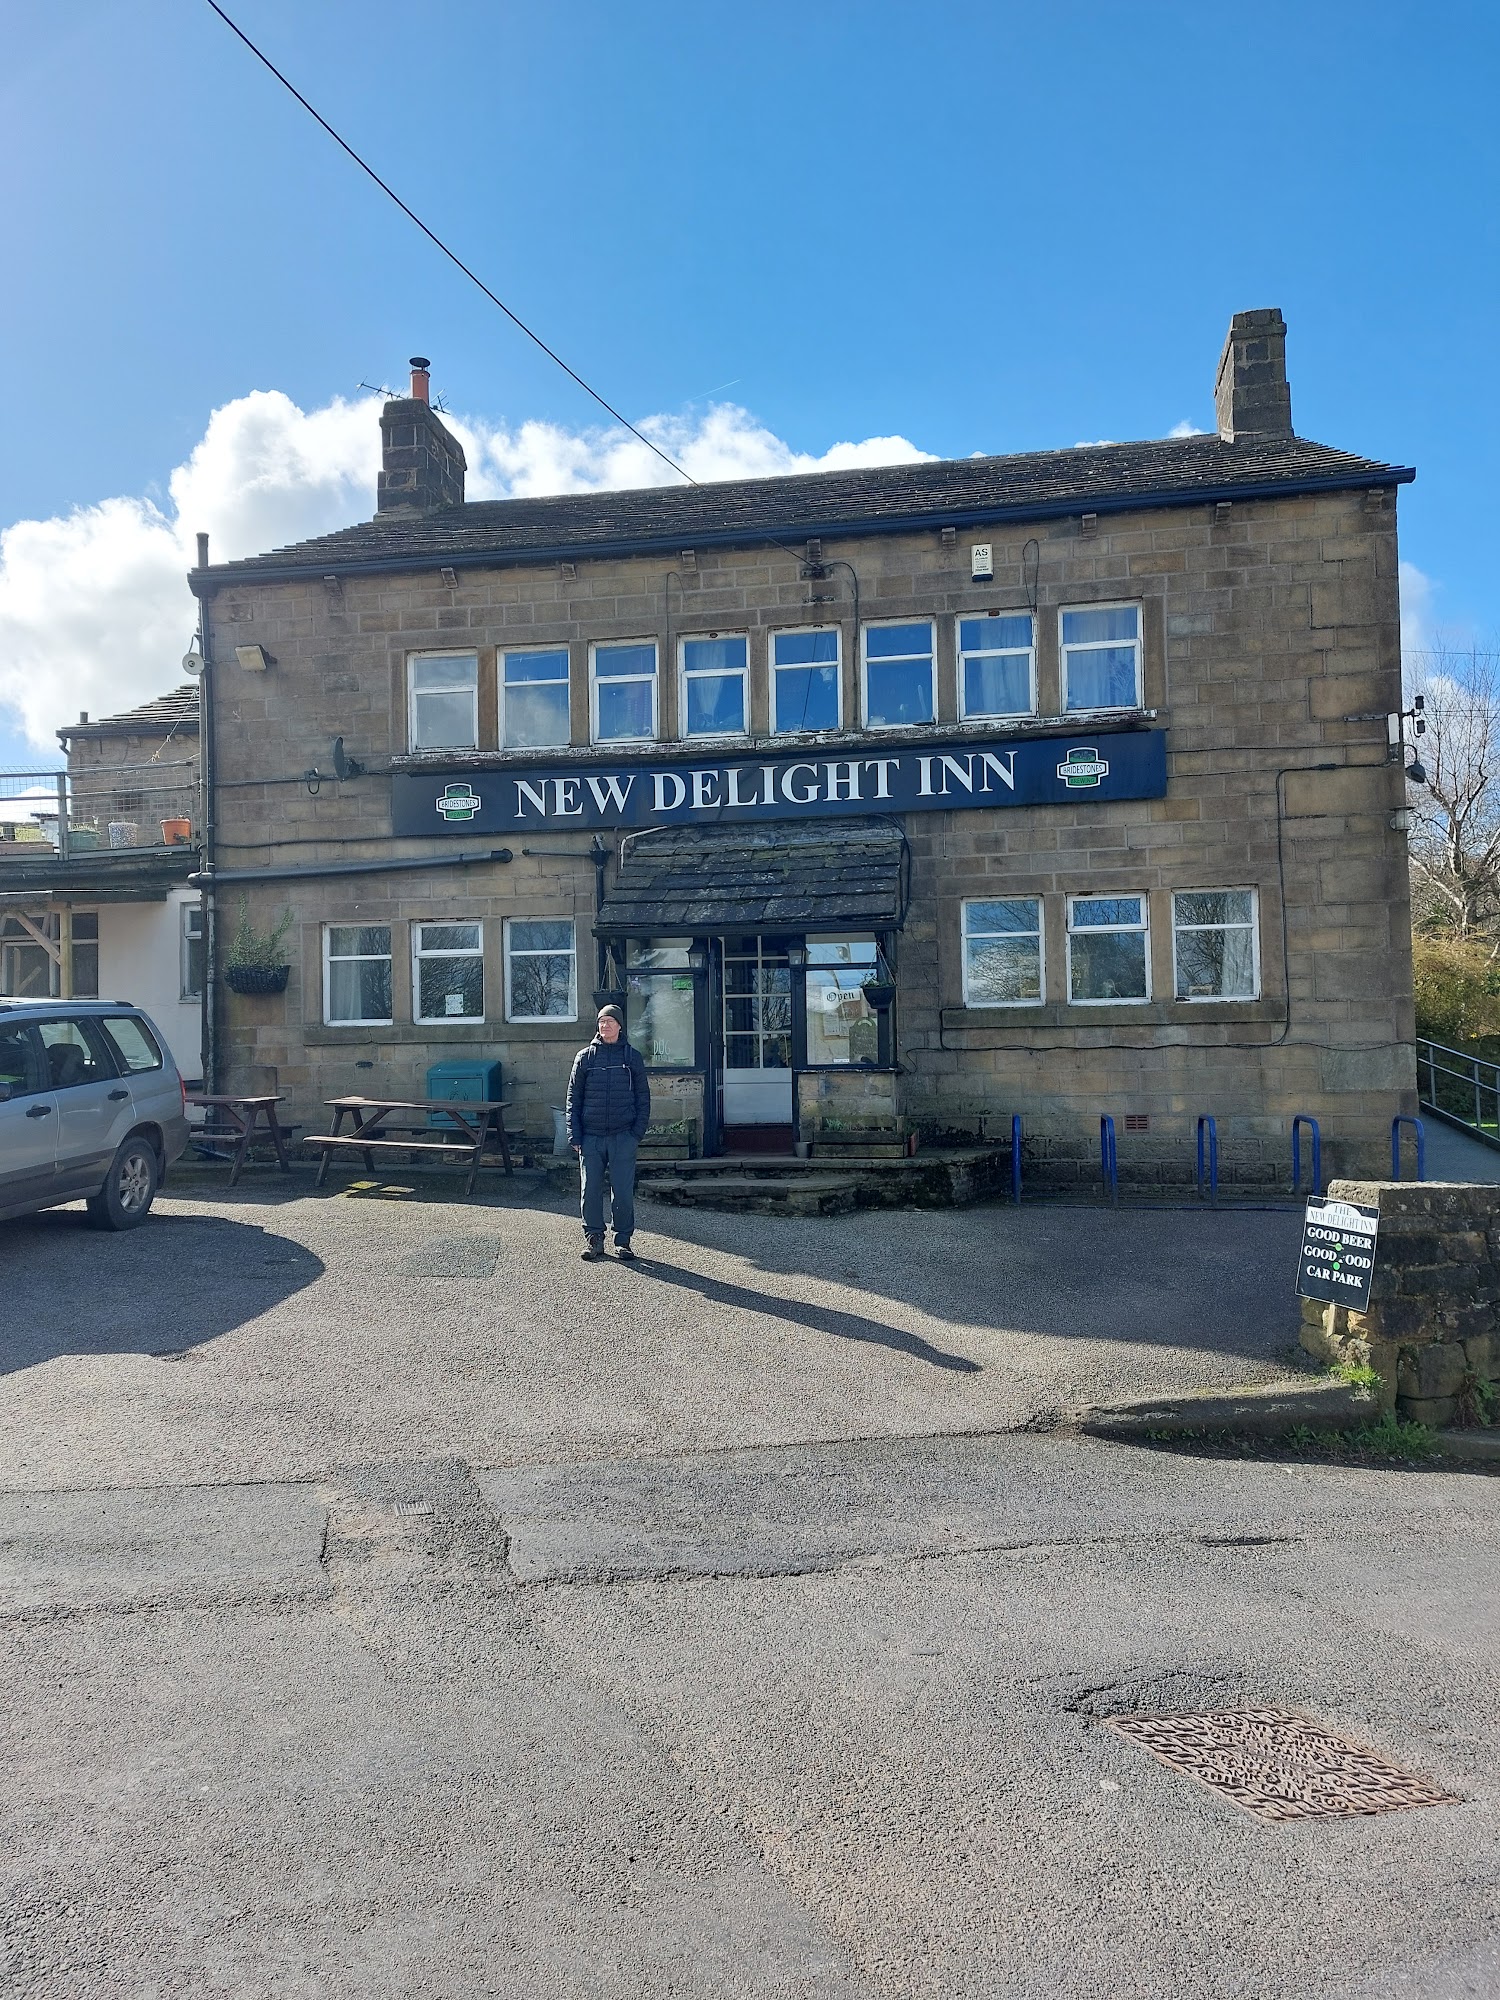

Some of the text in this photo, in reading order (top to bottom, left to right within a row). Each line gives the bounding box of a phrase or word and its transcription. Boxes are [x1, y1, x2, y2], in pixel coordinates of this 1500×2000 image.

[975, 548, 988, 556] AS
[1063, 764, 1102, 774] BRIDESTONES
[513, 750, 1018, 818] NEW DELIGHT INN
[441, 799, 476, 808] BRIDESTONES
[826, 991, 855, 1002] Open
[1334, 1205, 1352, 1216] THE
[1310, 1210, 1375, 1232] NEW DELIGHT INN
[1307, 1226, 1372, 1250] GOOD BEER
[1304, 1245, 1337, 1262] GOOD
[1306, 1265, 1364, 1288] CAR PARK
